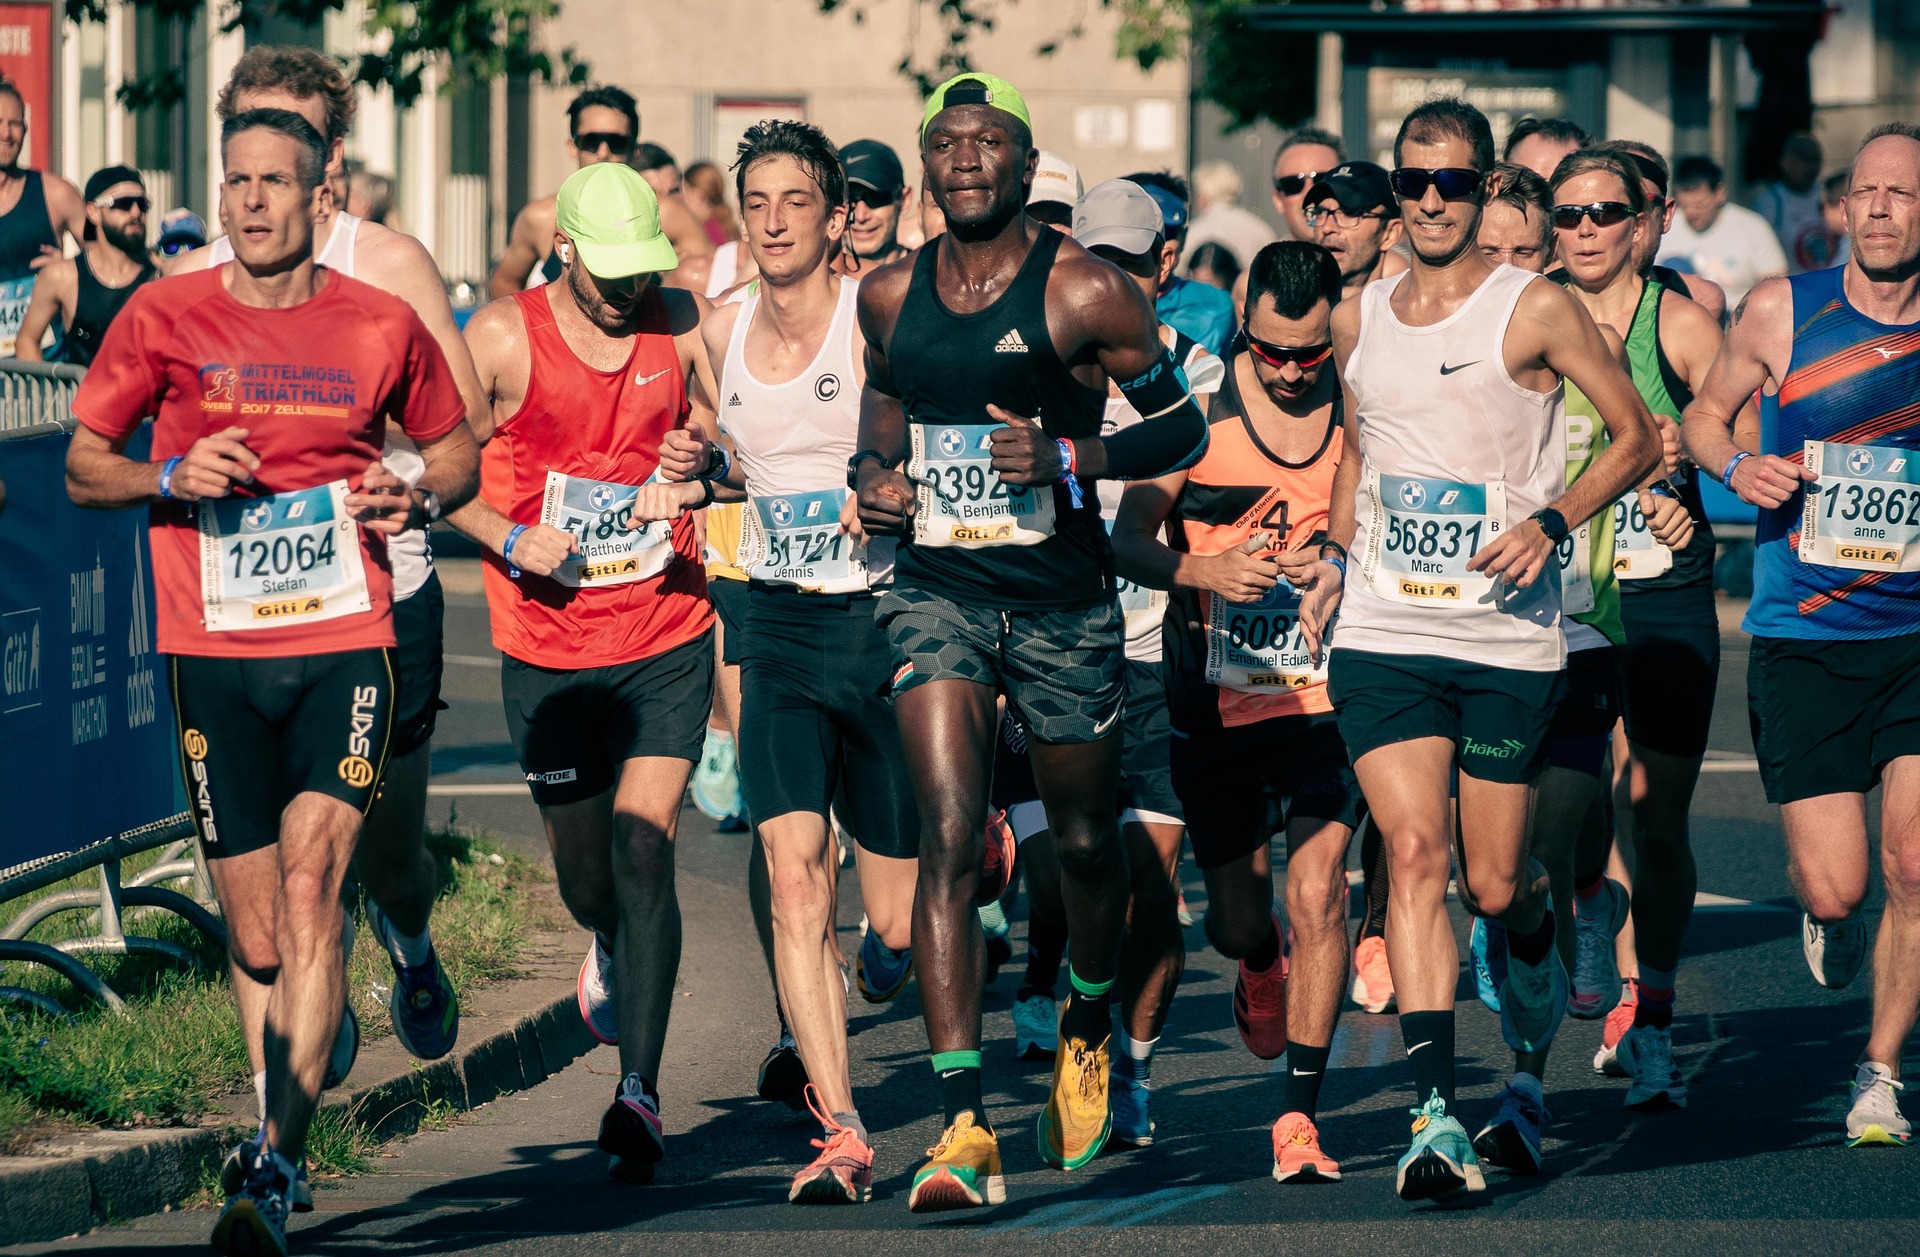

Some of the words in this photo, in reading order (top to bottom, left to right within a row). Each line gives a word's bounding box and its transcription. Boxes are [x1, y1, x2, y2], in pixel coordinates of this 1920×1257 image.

[0, 24, 31, 56] STE
[995, 343, 1029, 353] adidas
[241, 362, 356, 384] MITTELMOSEL
[1120, 363, 1162, 391] cep
[241, 381, 356, 406] TRIATHLON
[240, 403, 271, 414] 2017
[273, 404, 305, 416] ZELL
[1565, 415, 1593, 461] B
[925, 465, 1028, 503] 2392
[963, 500, 1026, 519] Benjamin
[1824, 482, 1920, 526] 13862
[340, 520, 350, 532] C
[1235, 515, 1250, 529] Club
[1260, 500, 1293, 541] 4
[1368, 484, 1378, 553] BERLIN-MARATHON
[1375, 522, 1383, 538] 2021
[1491, 521, 1500, 532] B
[1614, 500, 1648, 535] 96
[954, 527, 989, 539] Giti
[1386, 514, 1483, 559] 56831
[1580, 529, 1587, 539] C
[1615, 539, 1628, 549] na
[1854, 527, 1886, 539] anne
[201, 512, 214, 587] BERLIN-MARATHON
[229, 526, 337, 578] 12064
[579, 541, 633, 559] Matthew
[765, 531, 843, 567] 51721
[1559, 534, 1575, 570] 9
[1841, 547, 1876, 560] Giti
[581, 564, 617, 577] Giti
[1411, 559, 1444, 574] Marc
[262, 577, 308, 593] Stefan
[1402, 583, 1435, 596] Giti
[70, 570, 92, 634] BMW
[257, 601, 297, 616] Giti
[1210, 592, 1219, 650] BERLIN-MARATH
[3, 630, 27, 696] Giti
[71, 642, 93, 690] BERLIN
[1228, 649, 1278, 667] Emanuel
[1281, 653, 1327, 666] Eduao
[127, 653, 155, 730] adidas
[1251, 676, 1287, 685] Giti
[72, 693, 108, 746] MARATHON
[349, 685, 378, 758] SKINS
[191, 760, 218, 843] SKINS
